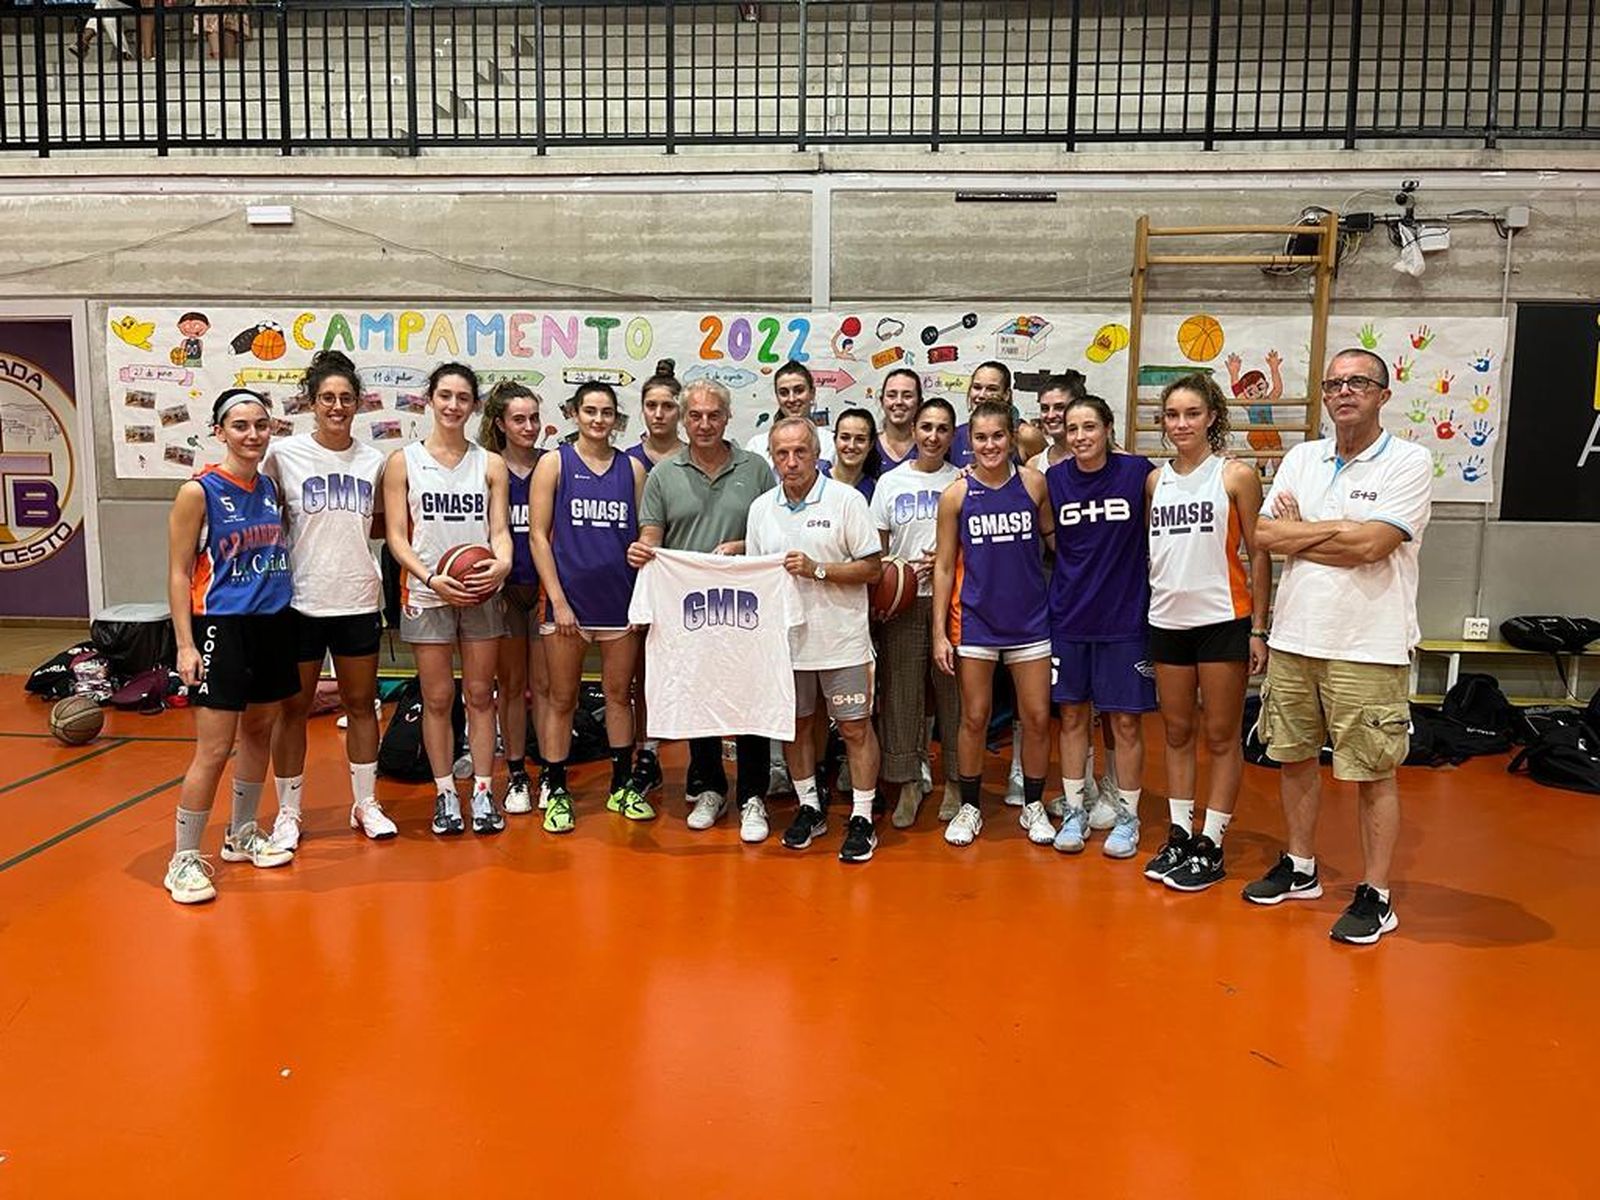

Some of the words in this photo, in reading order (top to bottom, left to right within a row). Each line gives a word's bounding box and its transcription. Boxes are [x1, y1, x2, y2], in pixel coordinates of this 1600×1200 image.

[293, 312, 653, 360] CAMPAMENTO
[699, 316, 810, 363] 2022
[219, 496, 236, 513] 5
[302, 473, 373, 519] GMB
[421, 491, 485, 514] GMASB
[571, 498, 629, 522] GMASB
[967, 510, 1033, 537] GMASB
[1059, 498, 1131, 526] G+B
[1150, 500, 1214, 528] GMASB
[1, 522, 73, 564] CESTO
[683, 588, 759, 632] GMB
[198, 625, 217, 695] COSTA
